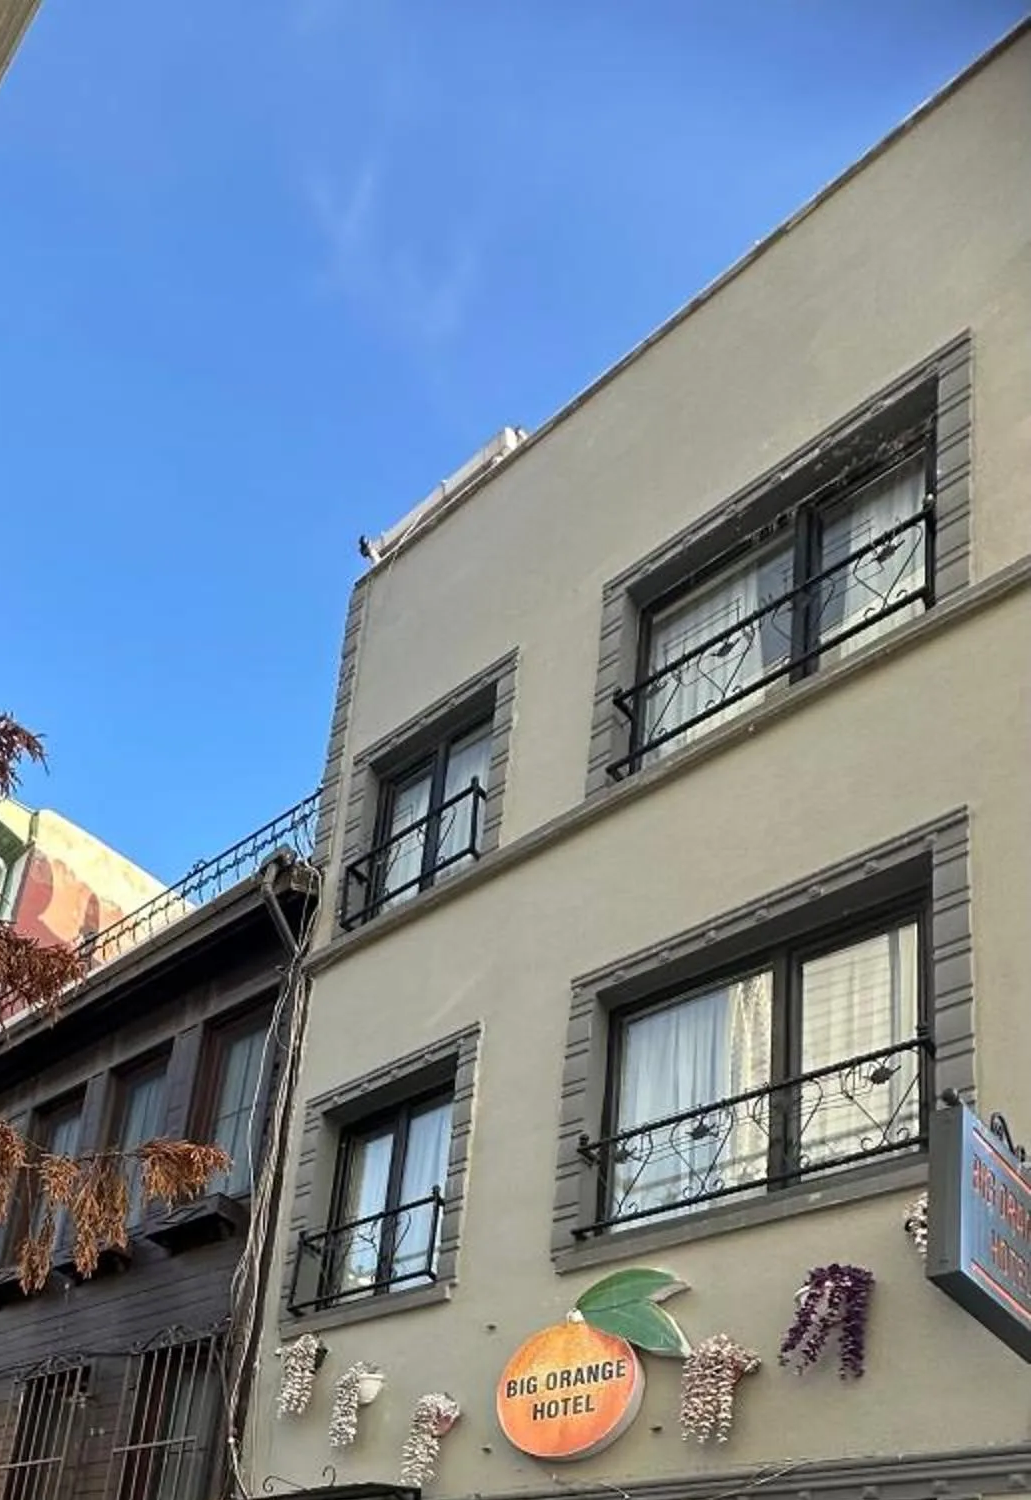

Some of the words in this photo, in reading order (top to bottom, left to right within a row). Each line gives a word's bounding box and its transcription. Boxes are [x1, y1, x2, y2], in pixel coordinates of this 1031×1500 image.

[506, 1376, 538, 1398] BIG
[546, 1358, 627, 1390] ORANGE
[532, 1394, 595, 1420] HOTEL
